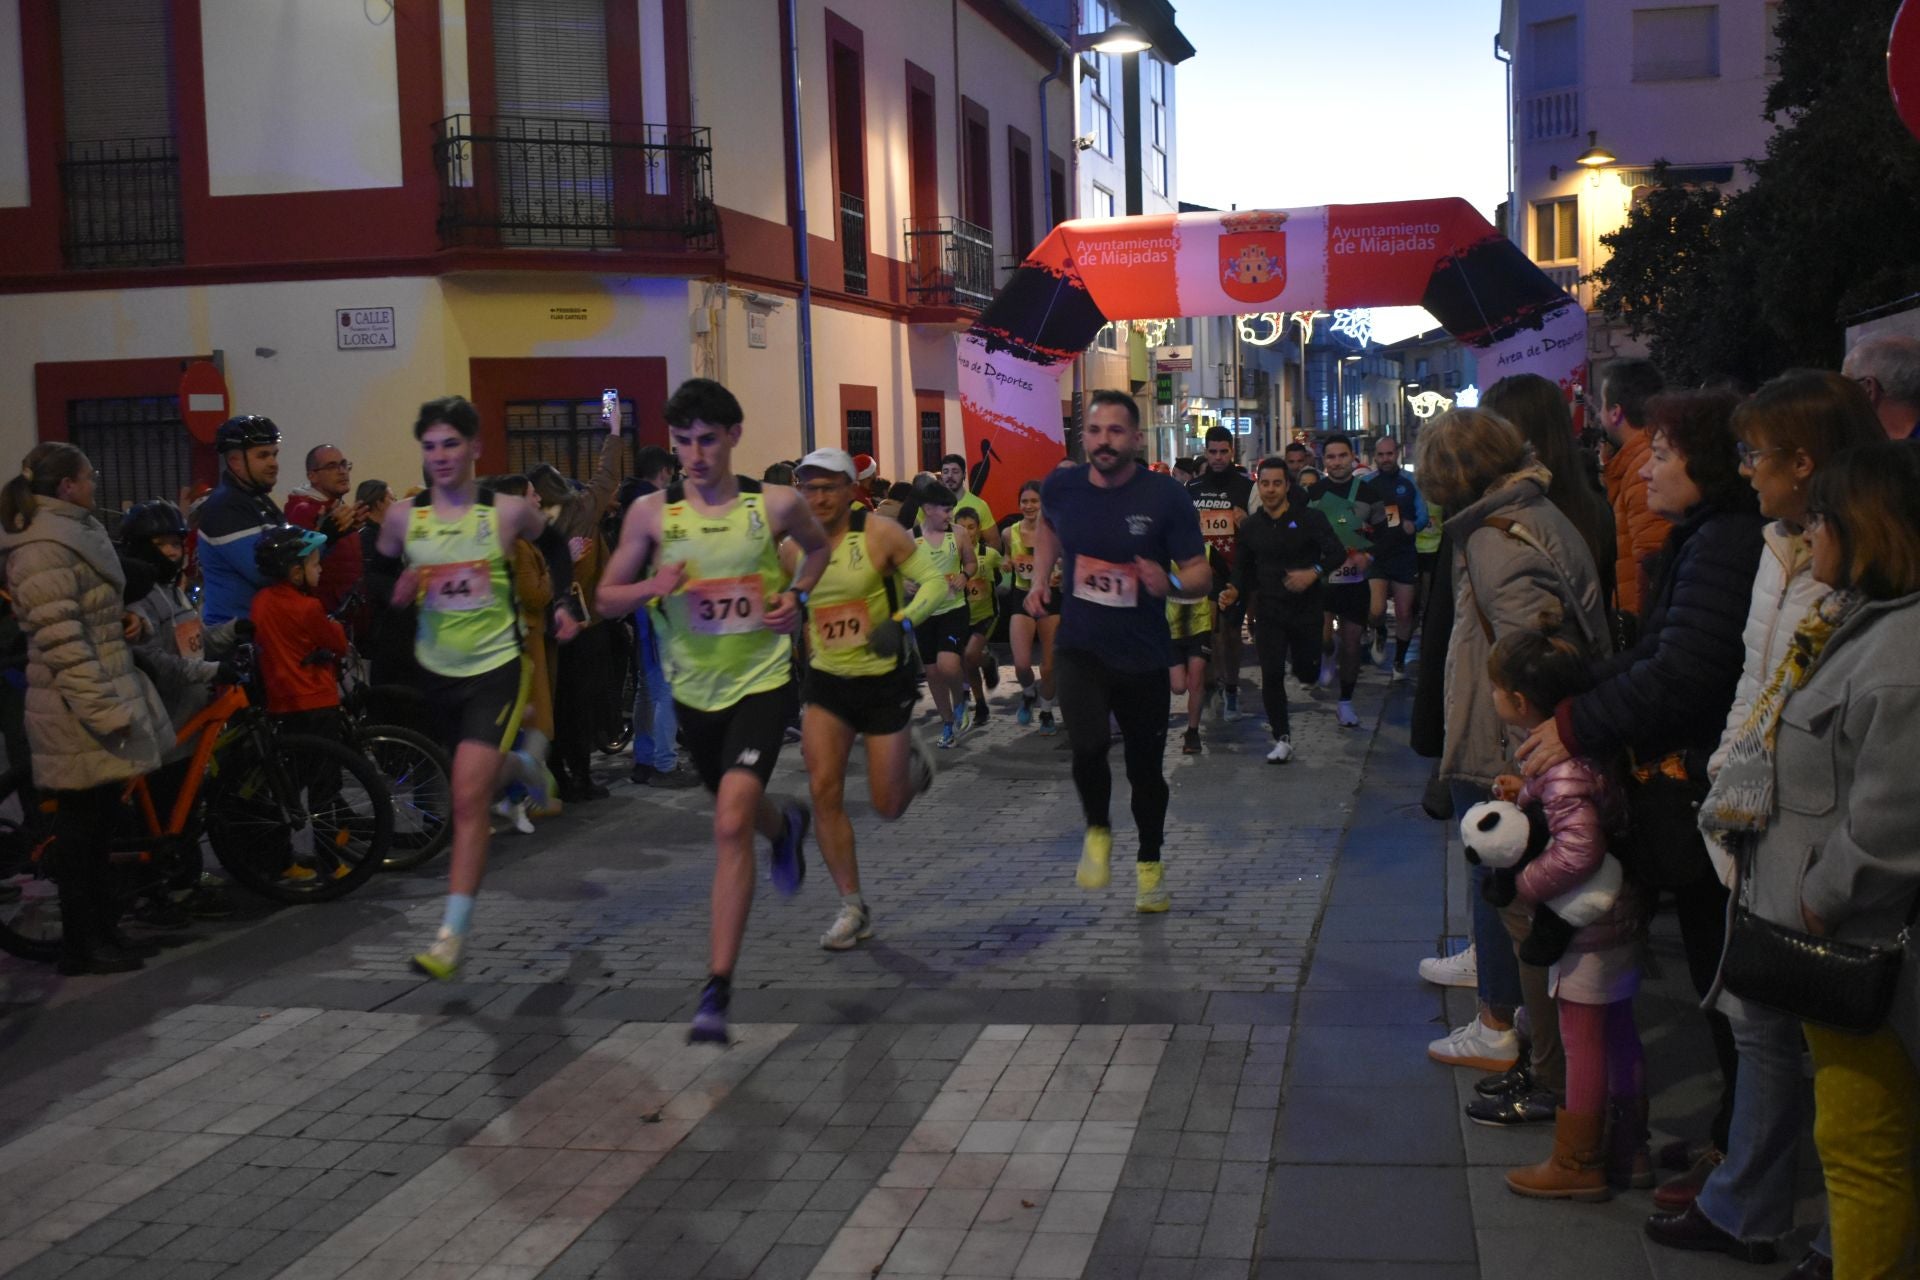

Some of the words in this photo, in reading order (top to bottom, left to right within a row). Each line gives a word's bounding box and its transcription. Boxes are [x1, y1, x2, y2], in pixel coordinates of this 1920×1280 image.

[1332, 223, 1440, 241] Ayuntamiento
[1077, 238, 1173, 254] Ayuntamiento
[1334, 239, 1356, 254] de
[1360, 234, 1436, 255] Miajadas
[1078, 251, 1097, 266] de
[1101, 248, 1168, 268] Miajadas
[355, 311, 389, 325] CALLE
[343, 333, 388, 345] LORCA
[1526, 345, 1541, 357] de
[970, 361, 982, 374] de
[984, 362, 1033, 391] Deportes
[1206, 519, 1228, 529] 160
[440, 579, 472, 598] 44
[1085, 574, 1122, 596] 431
[700, 597, 751, 621] 370
[823, 617, 861, 640] 279
